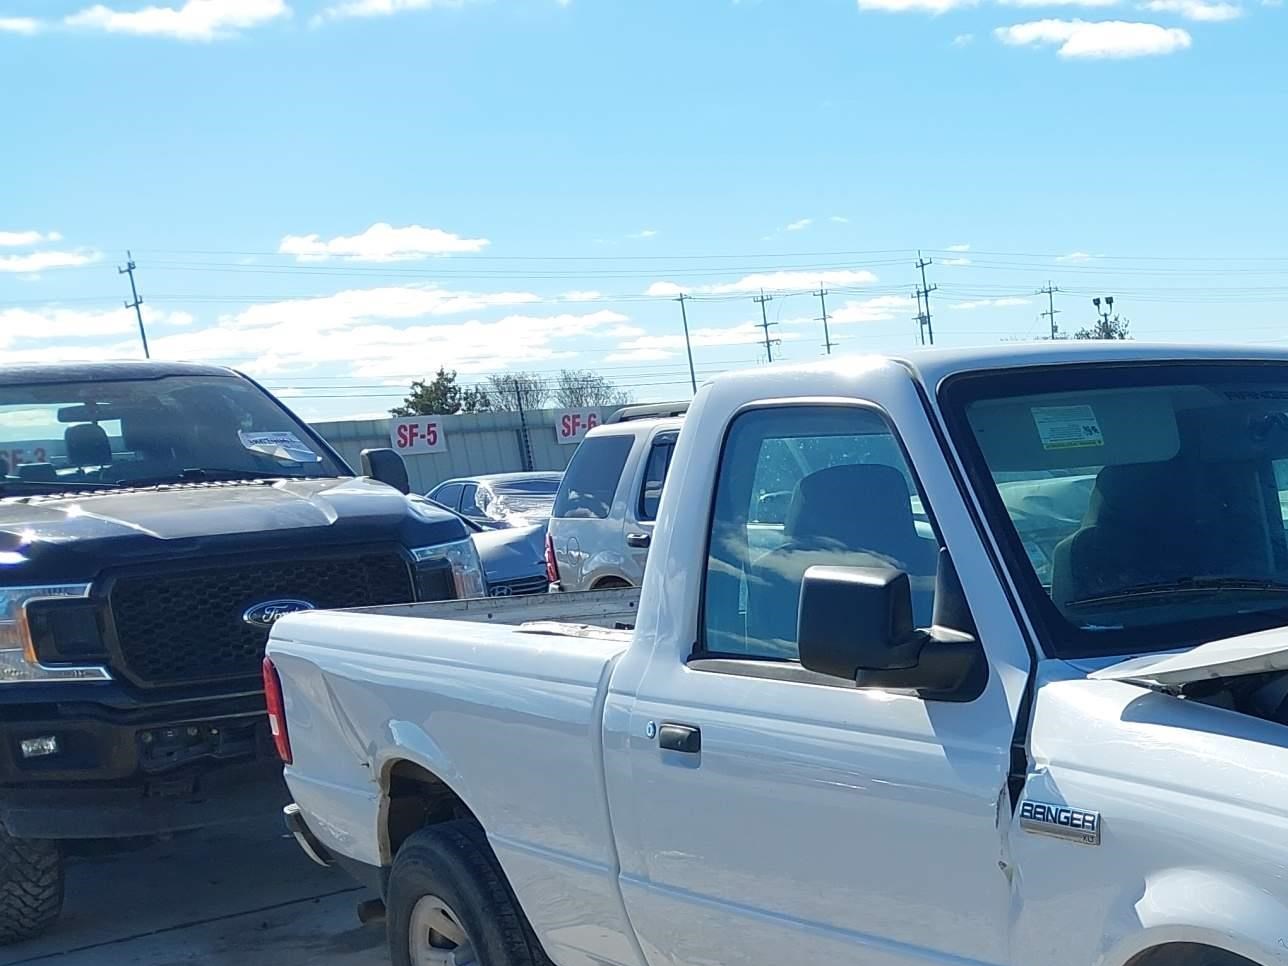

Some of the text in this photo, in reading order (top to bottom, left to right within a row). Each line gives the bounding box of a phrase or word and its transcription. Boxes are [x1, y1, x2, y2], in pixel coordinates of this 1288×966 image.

[397, 423, 438, 449] SF-5
[561, 413, 598, 438] SF-6
[261, 604, 300, 623] Fo
[1020, 802, 1096, 831] RANGER
